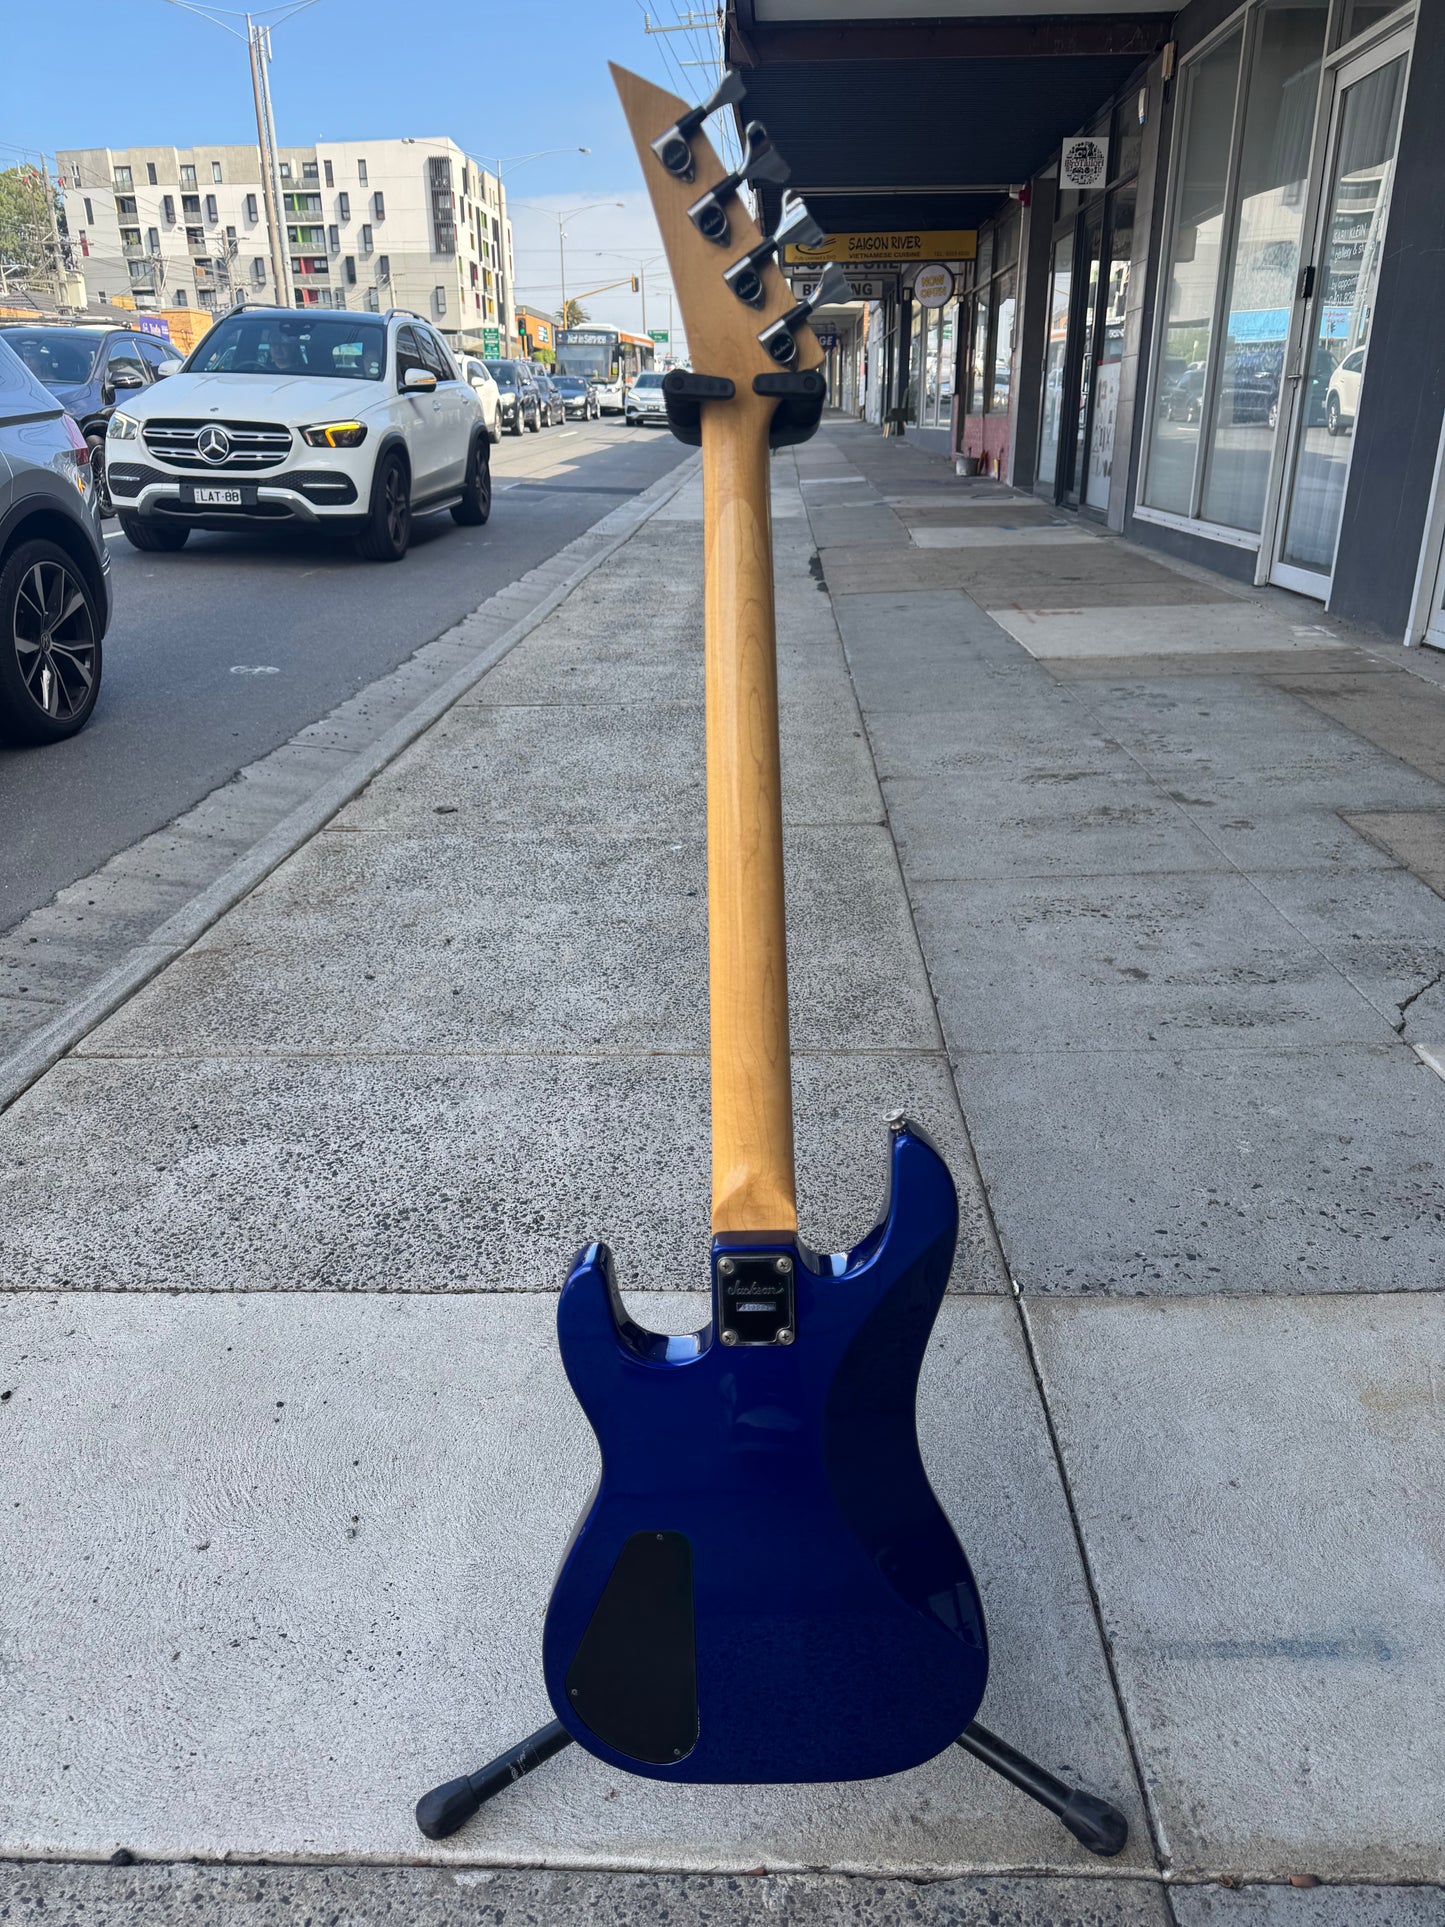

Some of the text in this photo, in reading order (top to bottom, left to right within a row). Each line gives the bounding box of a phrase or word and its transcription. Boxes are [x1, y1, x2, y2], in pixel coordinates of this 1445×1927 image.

[848, 235, 921, 251] SAIGON RIVER
[921, 275, 945, 287] NOW
[920, 287, 947, 298] OPEN
[727, 1279, 785, 1296] Jackson
